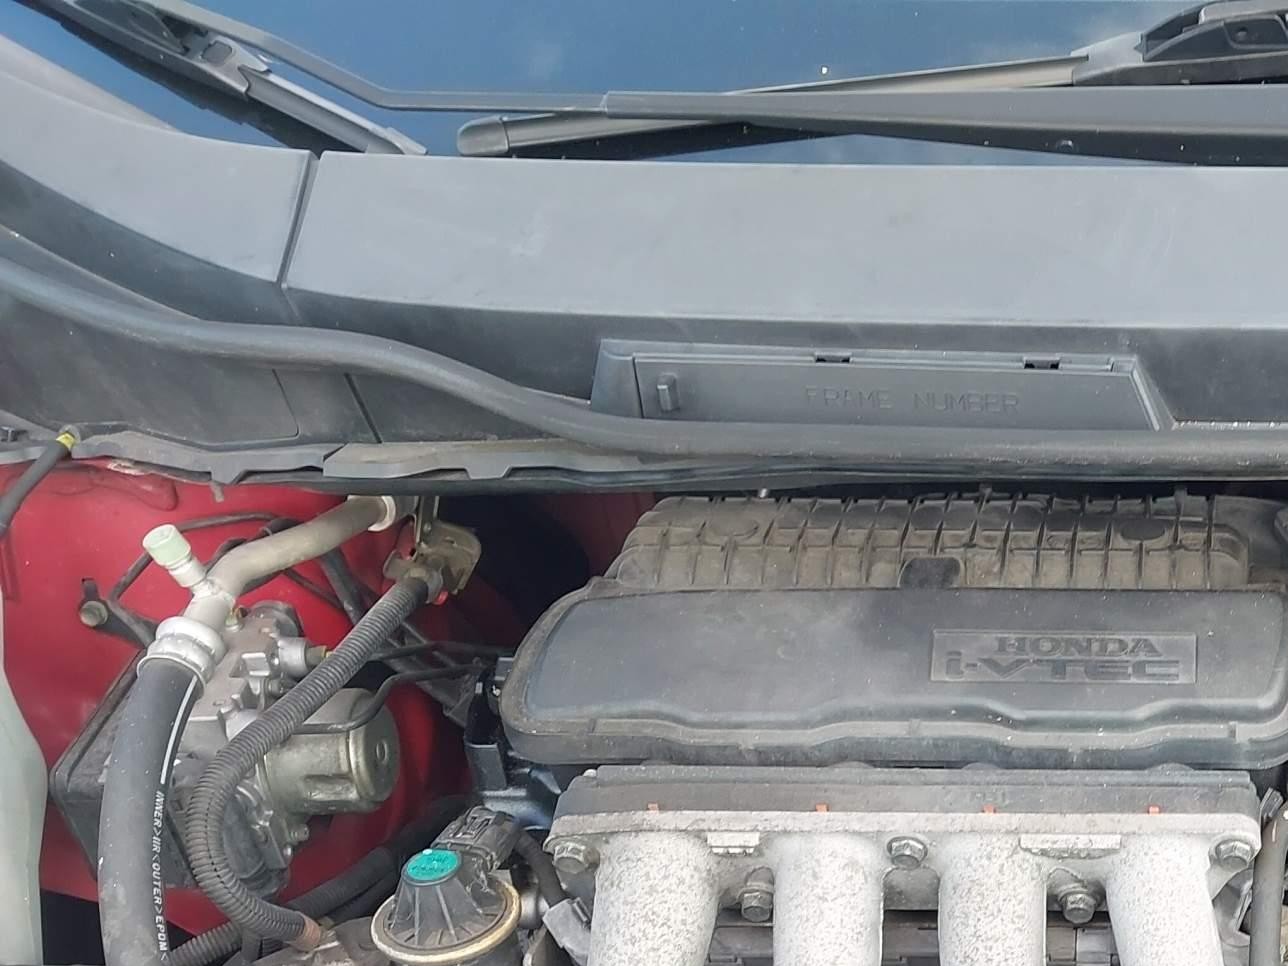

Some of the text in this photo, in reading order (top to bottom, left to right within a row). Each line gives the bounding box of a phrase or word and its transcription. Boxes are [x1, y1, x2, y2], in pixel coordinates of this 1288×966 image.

[805, 384, 1019, 415] FRAME NUMBER
[997, 636, 1164, 658] HONDA
[945, 650, 1180, 681] i-VTEC
